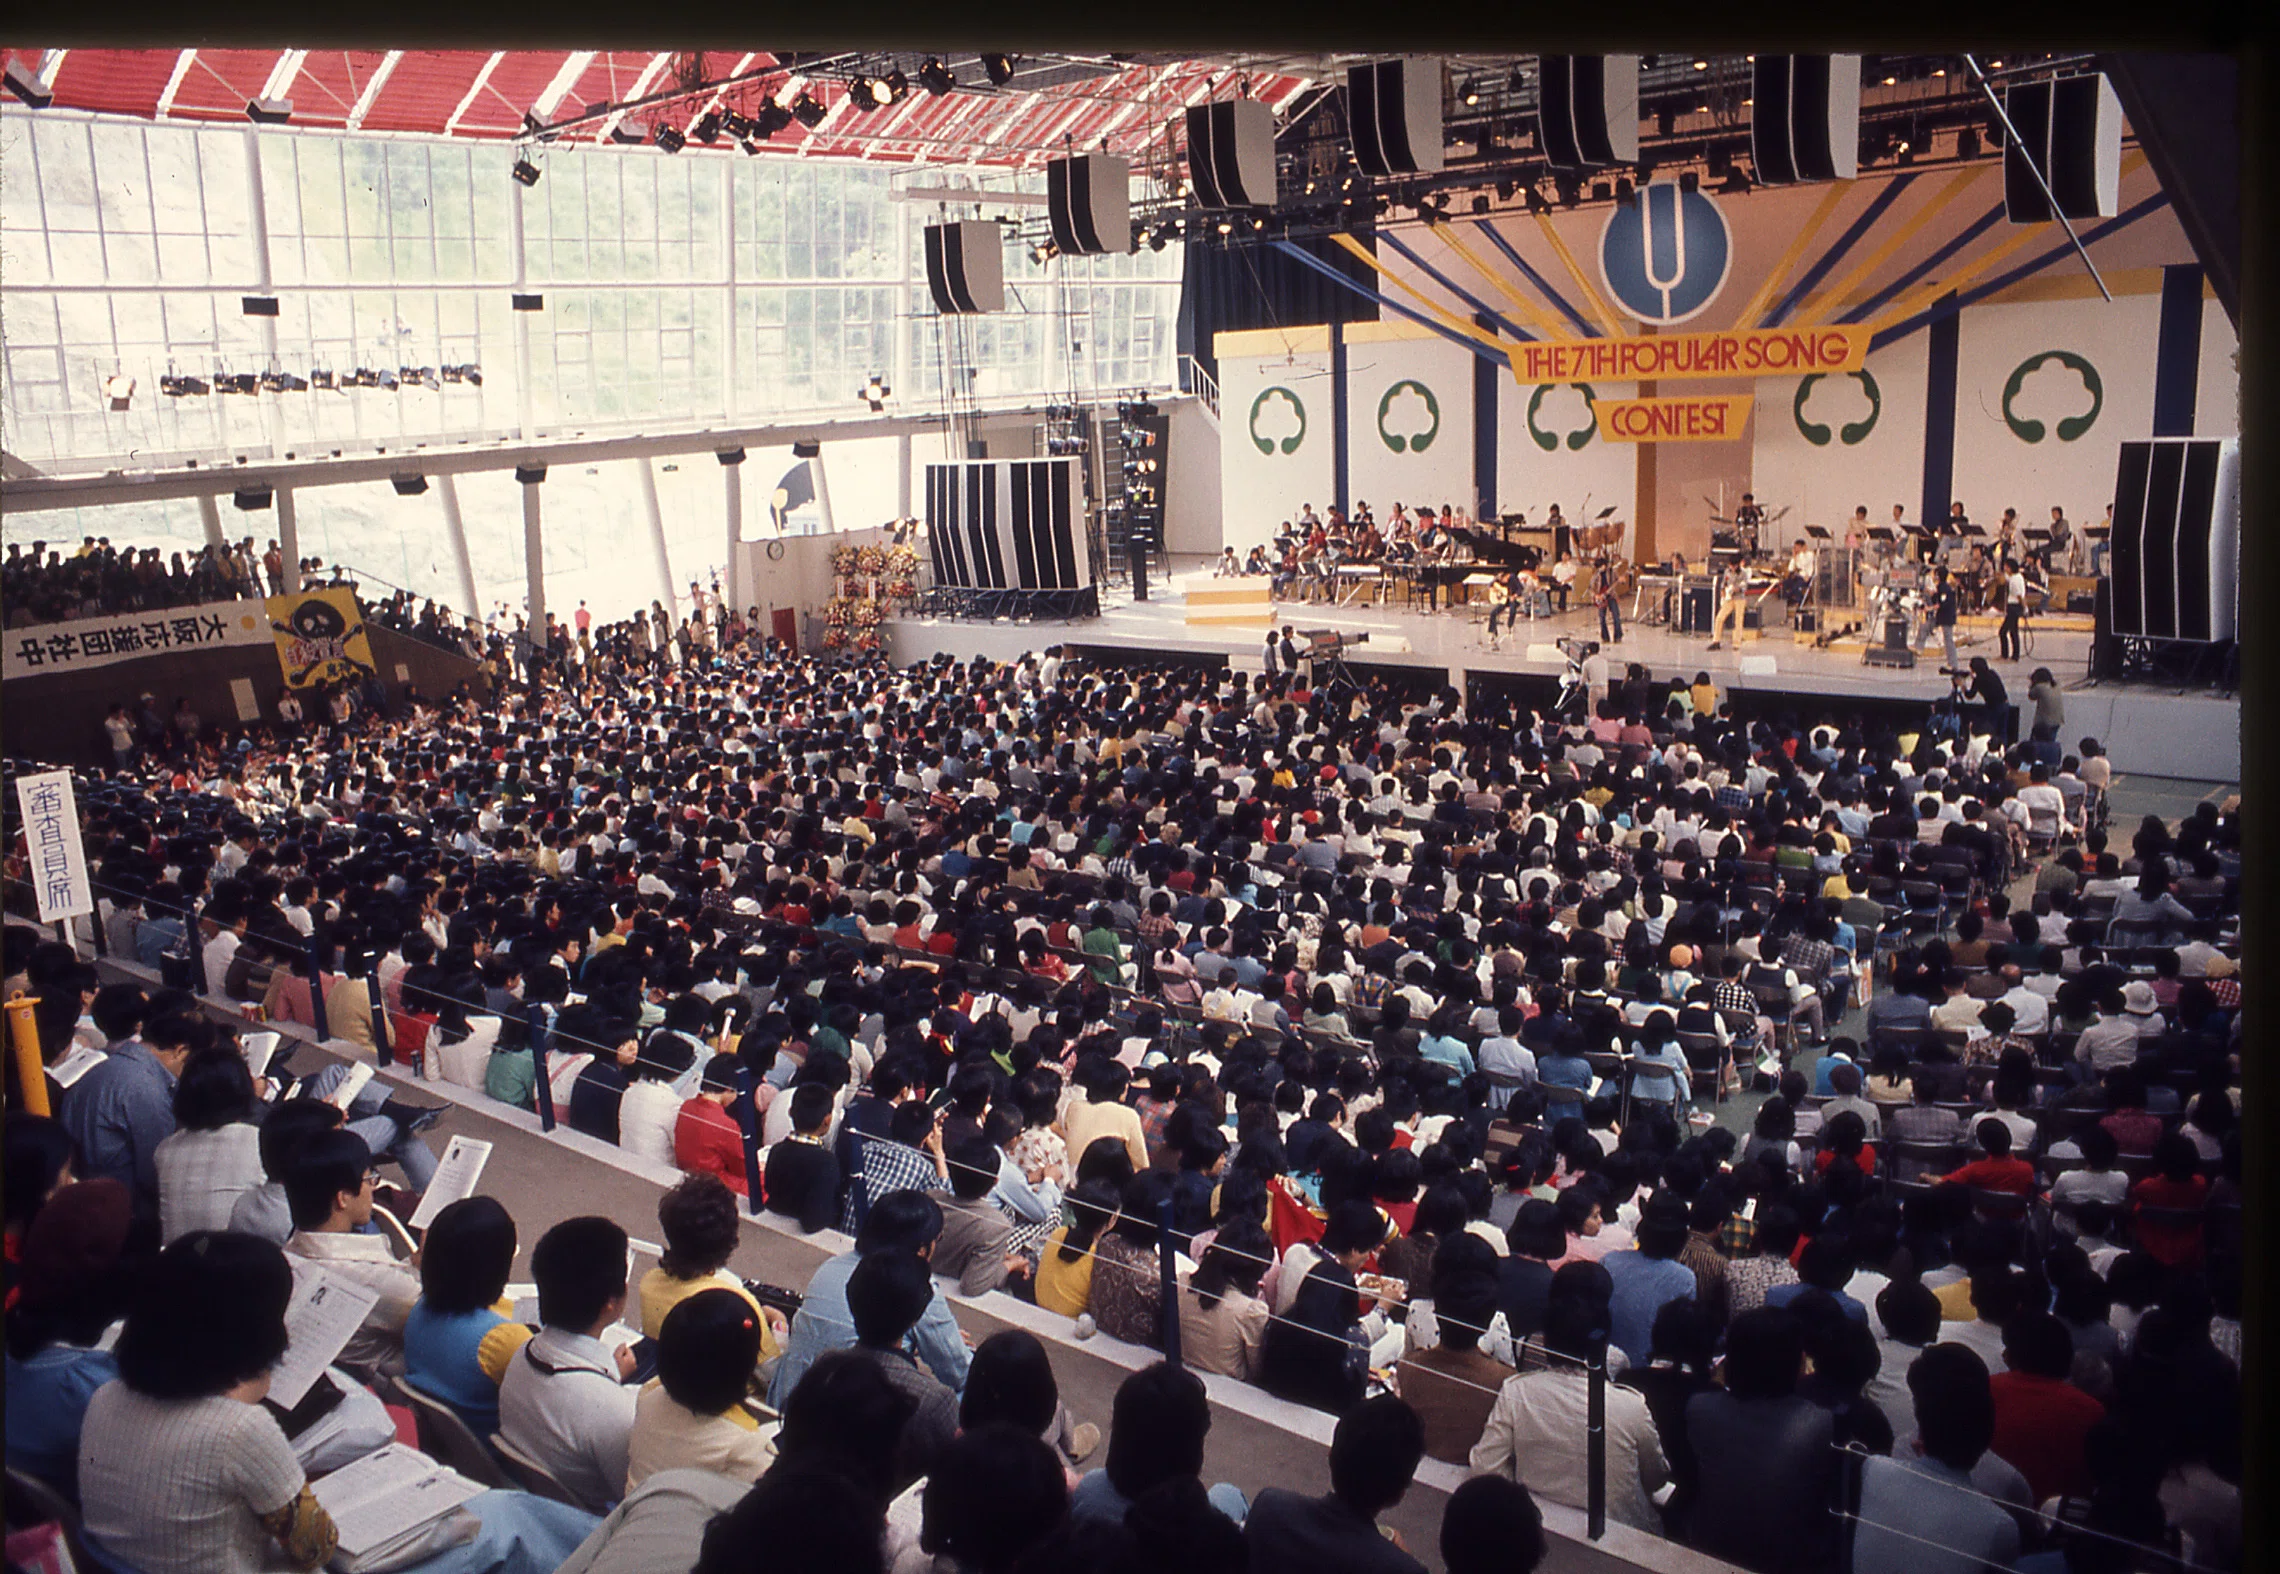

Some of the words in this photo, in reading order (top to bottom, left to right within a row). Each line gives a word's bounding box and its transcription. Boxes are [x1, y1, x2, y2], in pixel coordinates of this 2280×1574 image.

[1524, 347, 1567, 379] THE
[1571, 343, 1618, 377] 7TH
[1620, 338, 1740, 375] POPULAR
[1744, 333, 1851, 369] SONG
[1611, 402, 1730, 437] CONTEST
[16, 613, 228, 667] 大阪応援団社中
[26, 781, 74, 911] 審査員席
